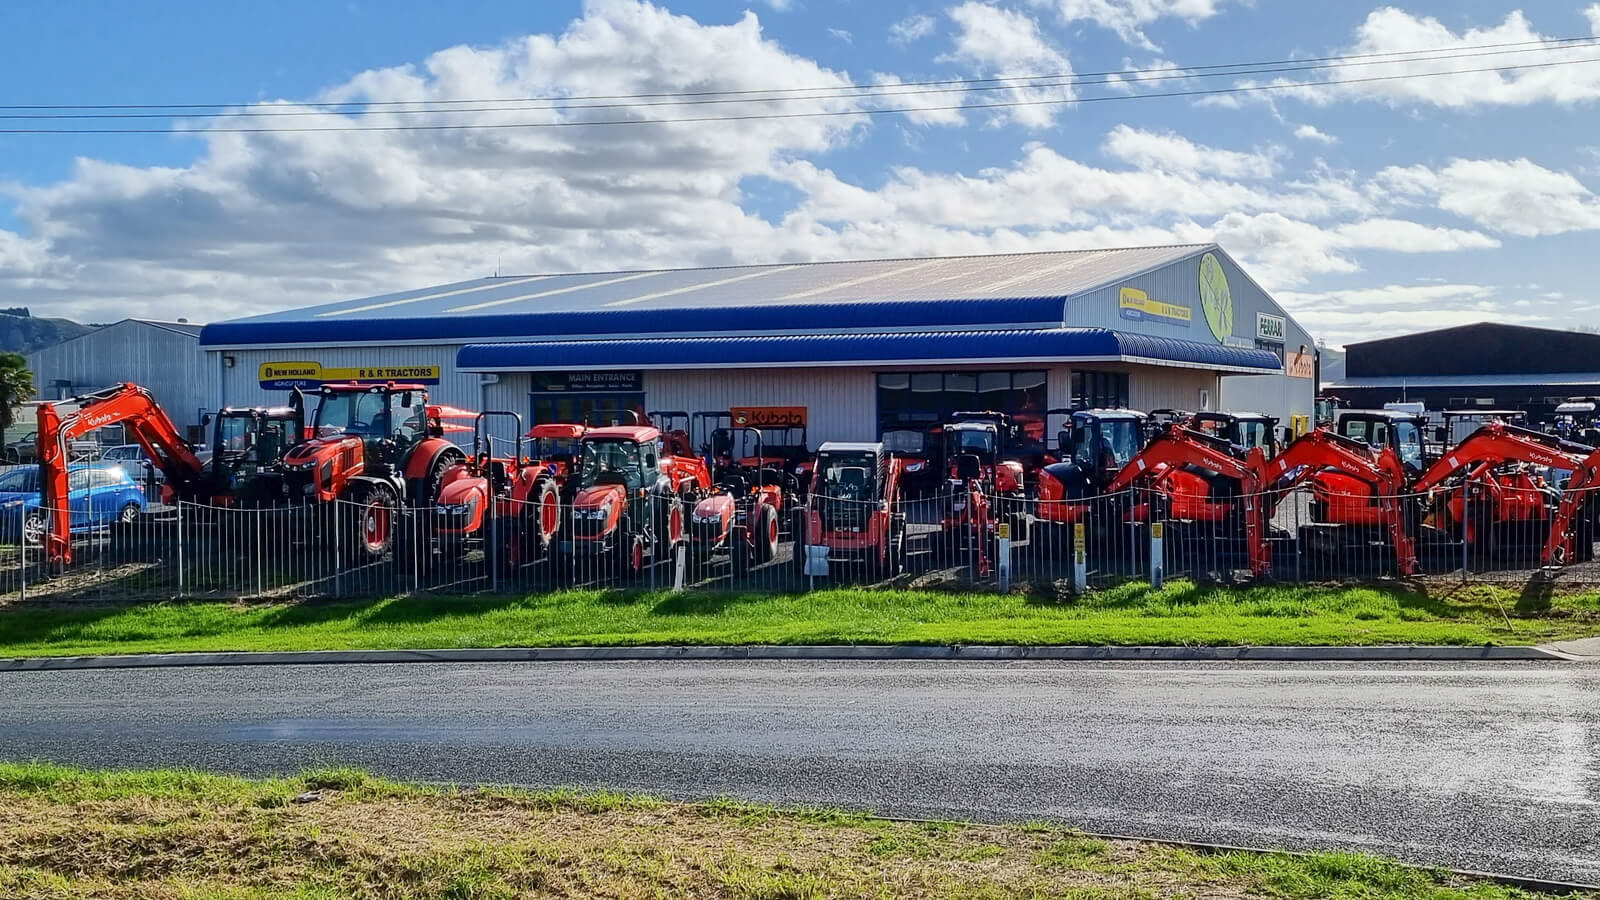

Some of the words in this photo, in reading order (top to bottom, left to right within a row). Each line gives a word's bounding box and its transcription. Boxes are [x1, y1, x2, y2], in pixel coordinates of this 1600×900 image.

[288, 368, 316, 376] HOLLAND
[360, 369, 365, 377] R
[368, 369, 374, 377] &
[377, 369, 383, 377] R
[385, 368, 432, 377] TRACTORS
[568, 373, 591, 382] MAIN
[593, 373, 635, 382] ENTRANCE
[87, 413, 112, 426] Kubota
[751, 410, 802, 425] Kubota
[1202, 456, 1223, 470] Kubota
[1529, 451, 1553, 463] Kubota
[1341, 460, 1360, 473] Kubota
